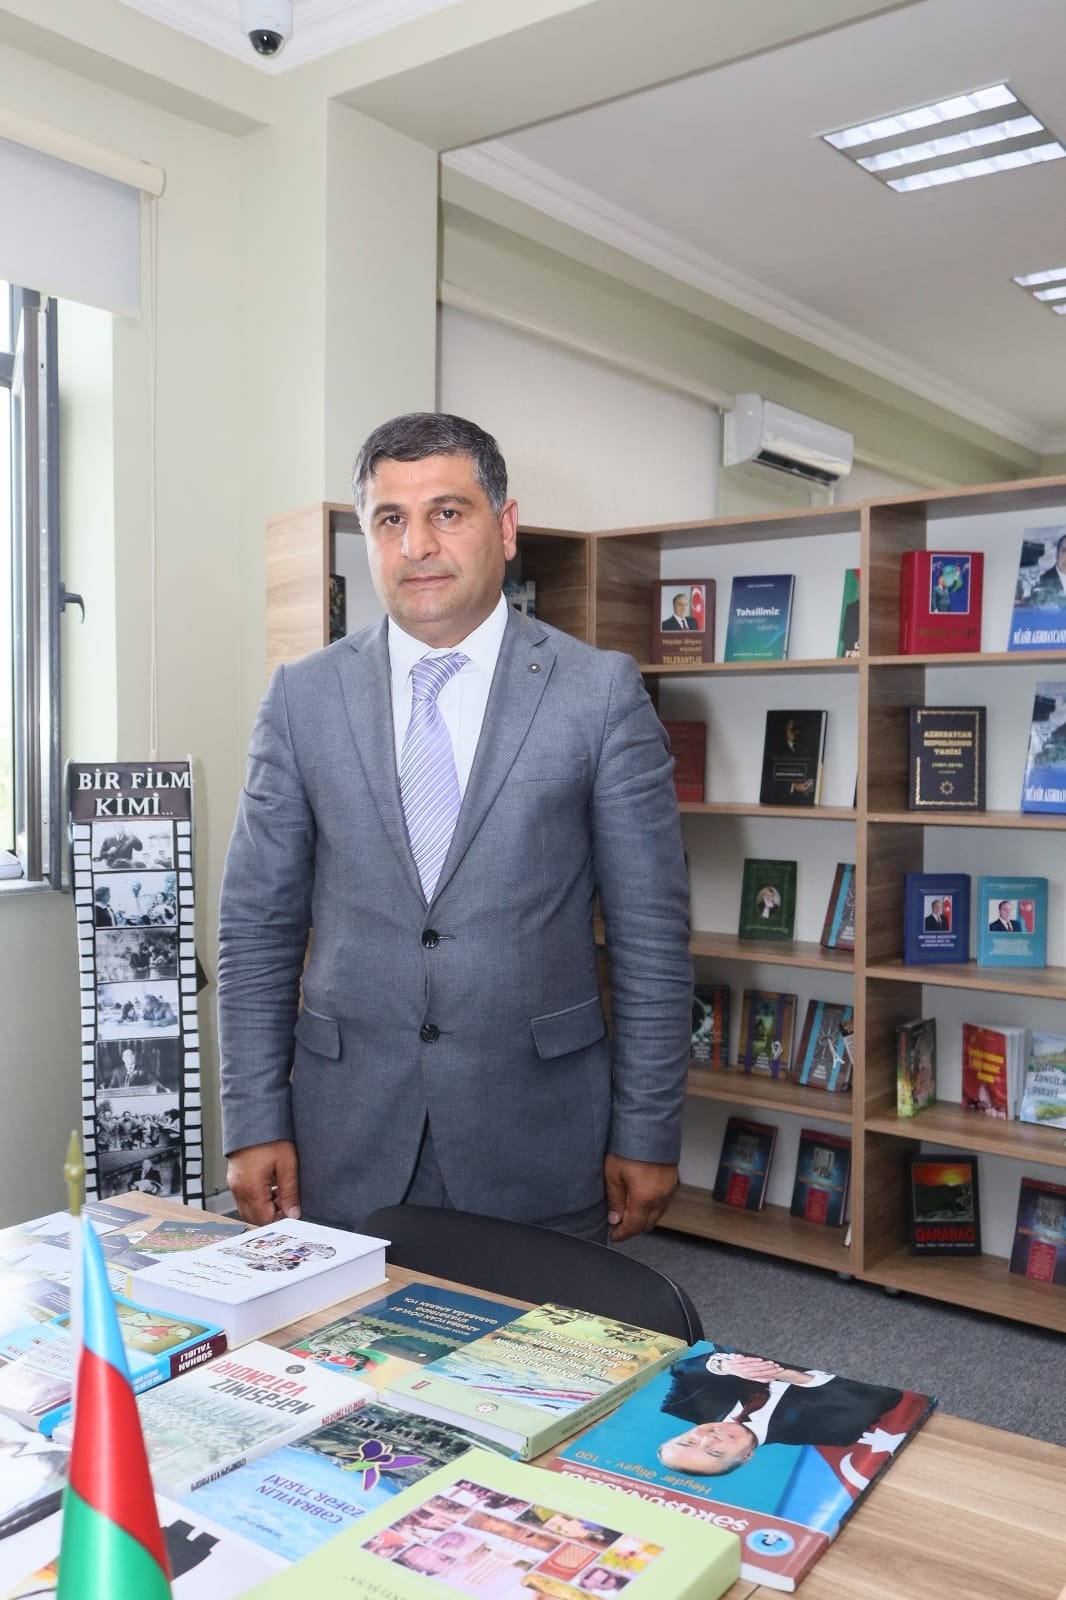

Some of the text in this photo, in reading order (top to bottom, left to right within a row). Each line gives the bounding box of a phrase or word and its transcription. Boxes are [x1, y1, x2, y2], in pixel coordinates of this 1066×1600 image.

[78, 767, 191, 790] BİR FİLM
[95, 792, 174, 816] KİMİ...
[915, 1225, 976, 1243] QARABAĞ
[178, 1350, 213, 1372] SÜBHAN
[575, 1450, 599, 1463] 100
[616, 1461, 657, 1479] Əliyev
[661, 1474, 712, 1495] Heydər
[256, 1485, 343, 1524] CƏBRAYILIN
[314, 1493, 366, 1518] ZƏFƏR
